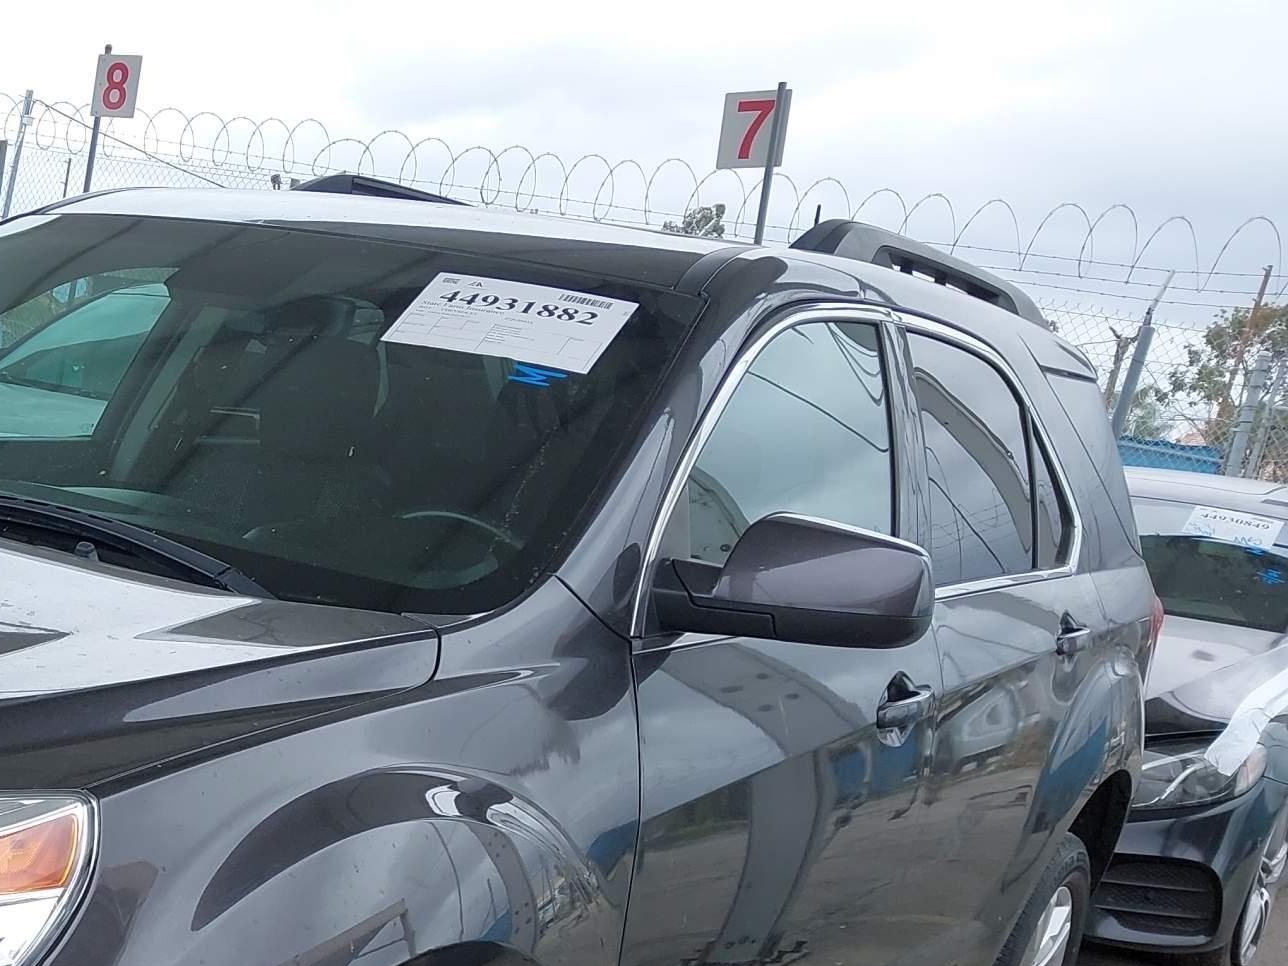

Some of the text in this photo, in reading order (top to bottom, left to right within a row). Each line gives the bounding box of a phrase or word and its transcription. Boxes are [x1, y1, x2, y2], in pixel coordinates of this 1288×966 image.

[102, 62, 129, 111] 8
[737, 99, 776, 160] 7
[439, 290, 598, 326] 44931882
